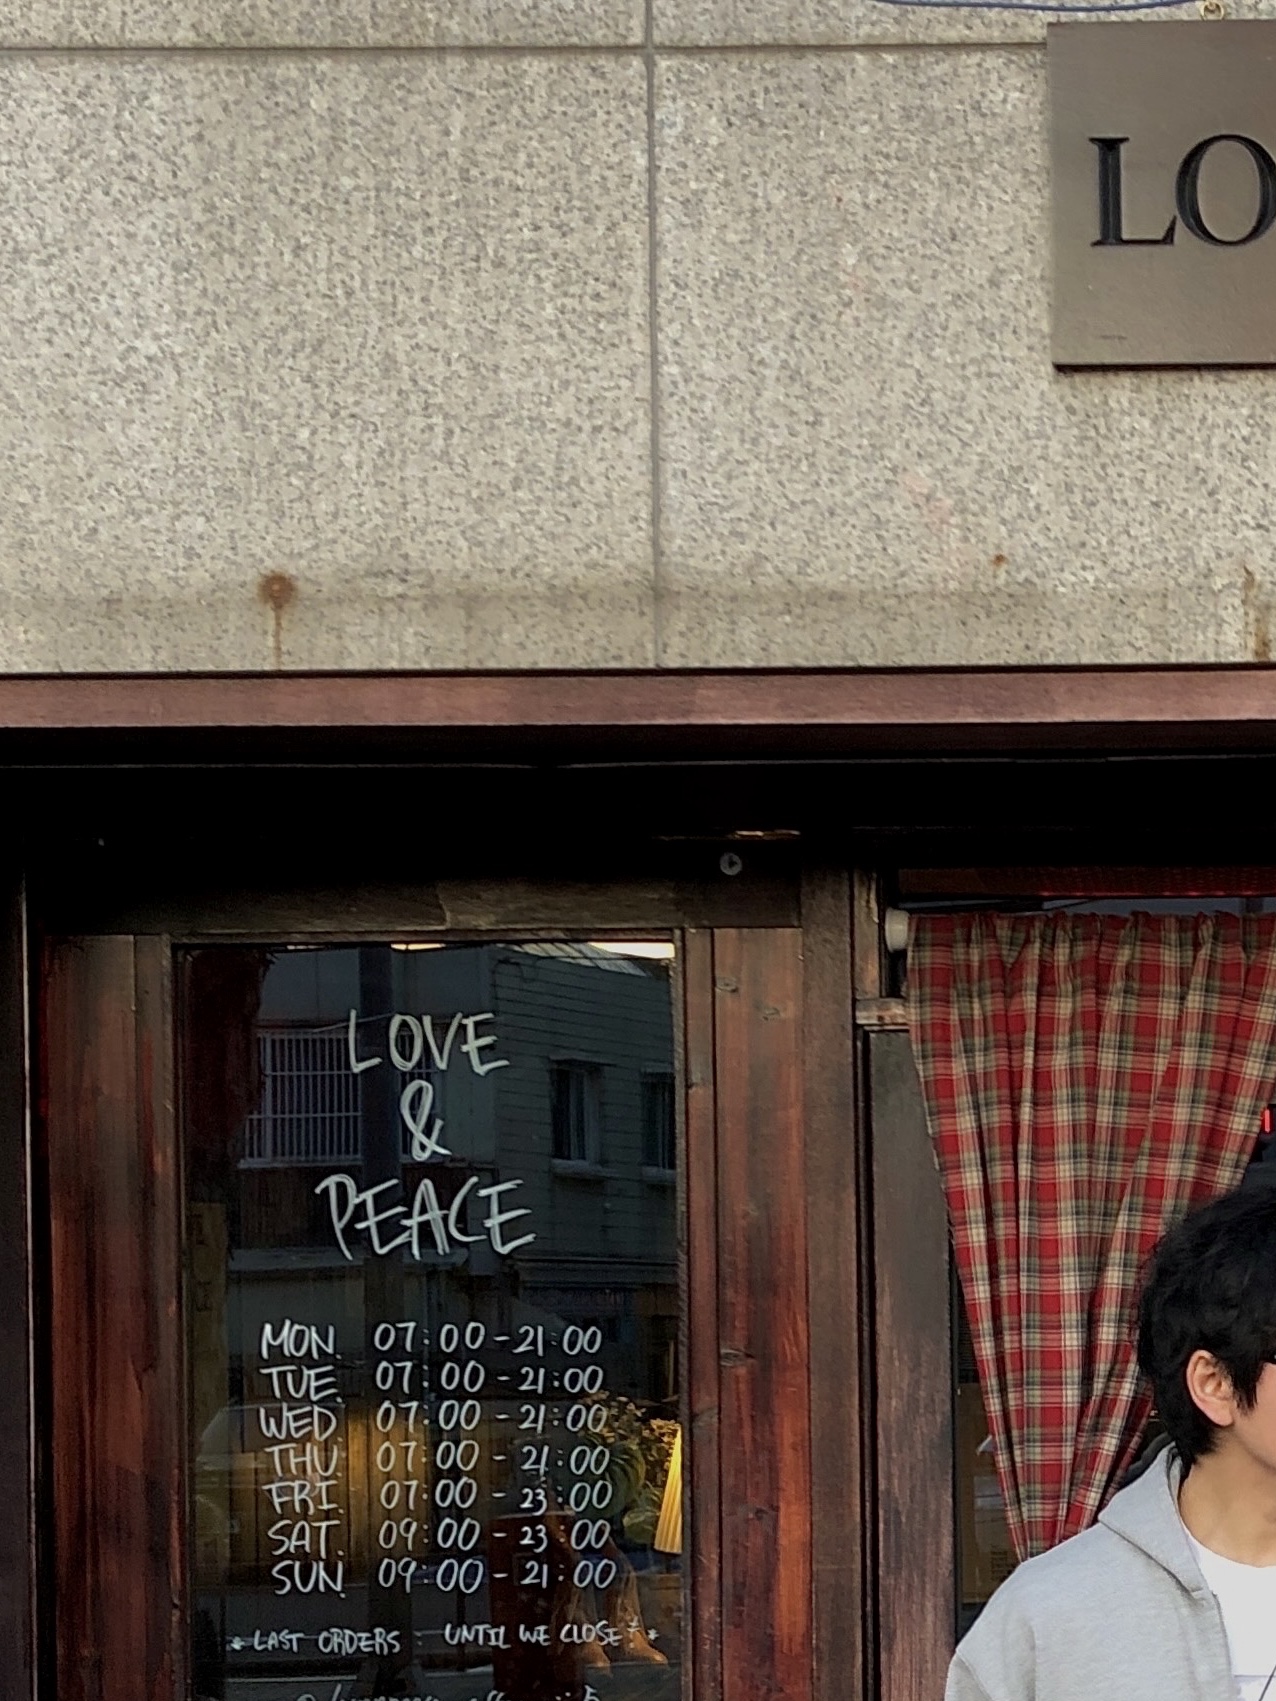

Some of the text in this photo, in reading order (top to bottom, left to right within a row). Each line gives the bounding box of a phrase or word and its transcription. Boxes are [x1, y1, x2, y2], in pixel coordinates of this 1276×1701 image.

[349, 1009, 510, 1075] LOVE
[400, 1080, 452, 1162] &
[315, 1174, 537, 1261] PEACE
[253, 1629, 304, 1652] LAST
[318, 1627, 400, 1656] ORDERS
[444, 1623, 511, 1649] UNTIL
[518, 1623, 550, 1646] WE
